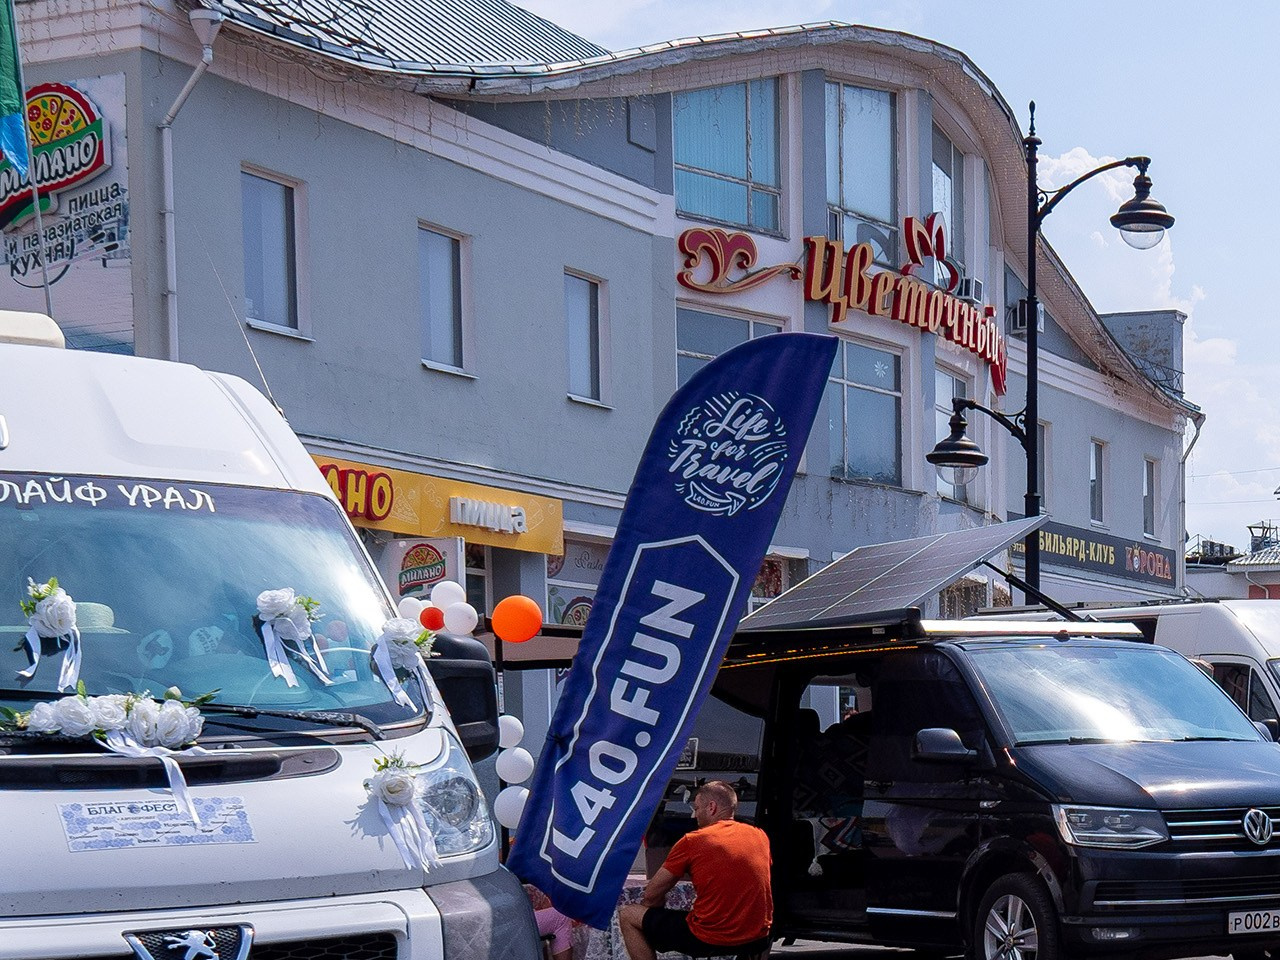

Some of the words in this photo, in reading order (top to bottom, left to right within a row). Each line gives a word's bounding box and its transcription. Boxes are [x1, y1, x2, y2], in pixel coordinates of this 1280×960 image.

[0, 133, 96, 200] МЛАНО
[69, 182, 121, 214] пицца
[803, 236, 1002, 365] Цветочный
[705, 398, 771, 441] Life
[668, 439, 779, 494] Travel
[710, 440, 748, 462] for
[118, 484, 216, 513] УРАЛ
[450, 496, 528, 535] пицца
[693, 492, 721, 508] L40.FUN
[401, 565, 443, 585] МИЛАНО
[1039, 530, 1115, 566] БИЛЬЯРД-КЛУБ
[1125, 545, 1172, 580] КОРОНА
[552, 580, 706, 859] L40.FUN
